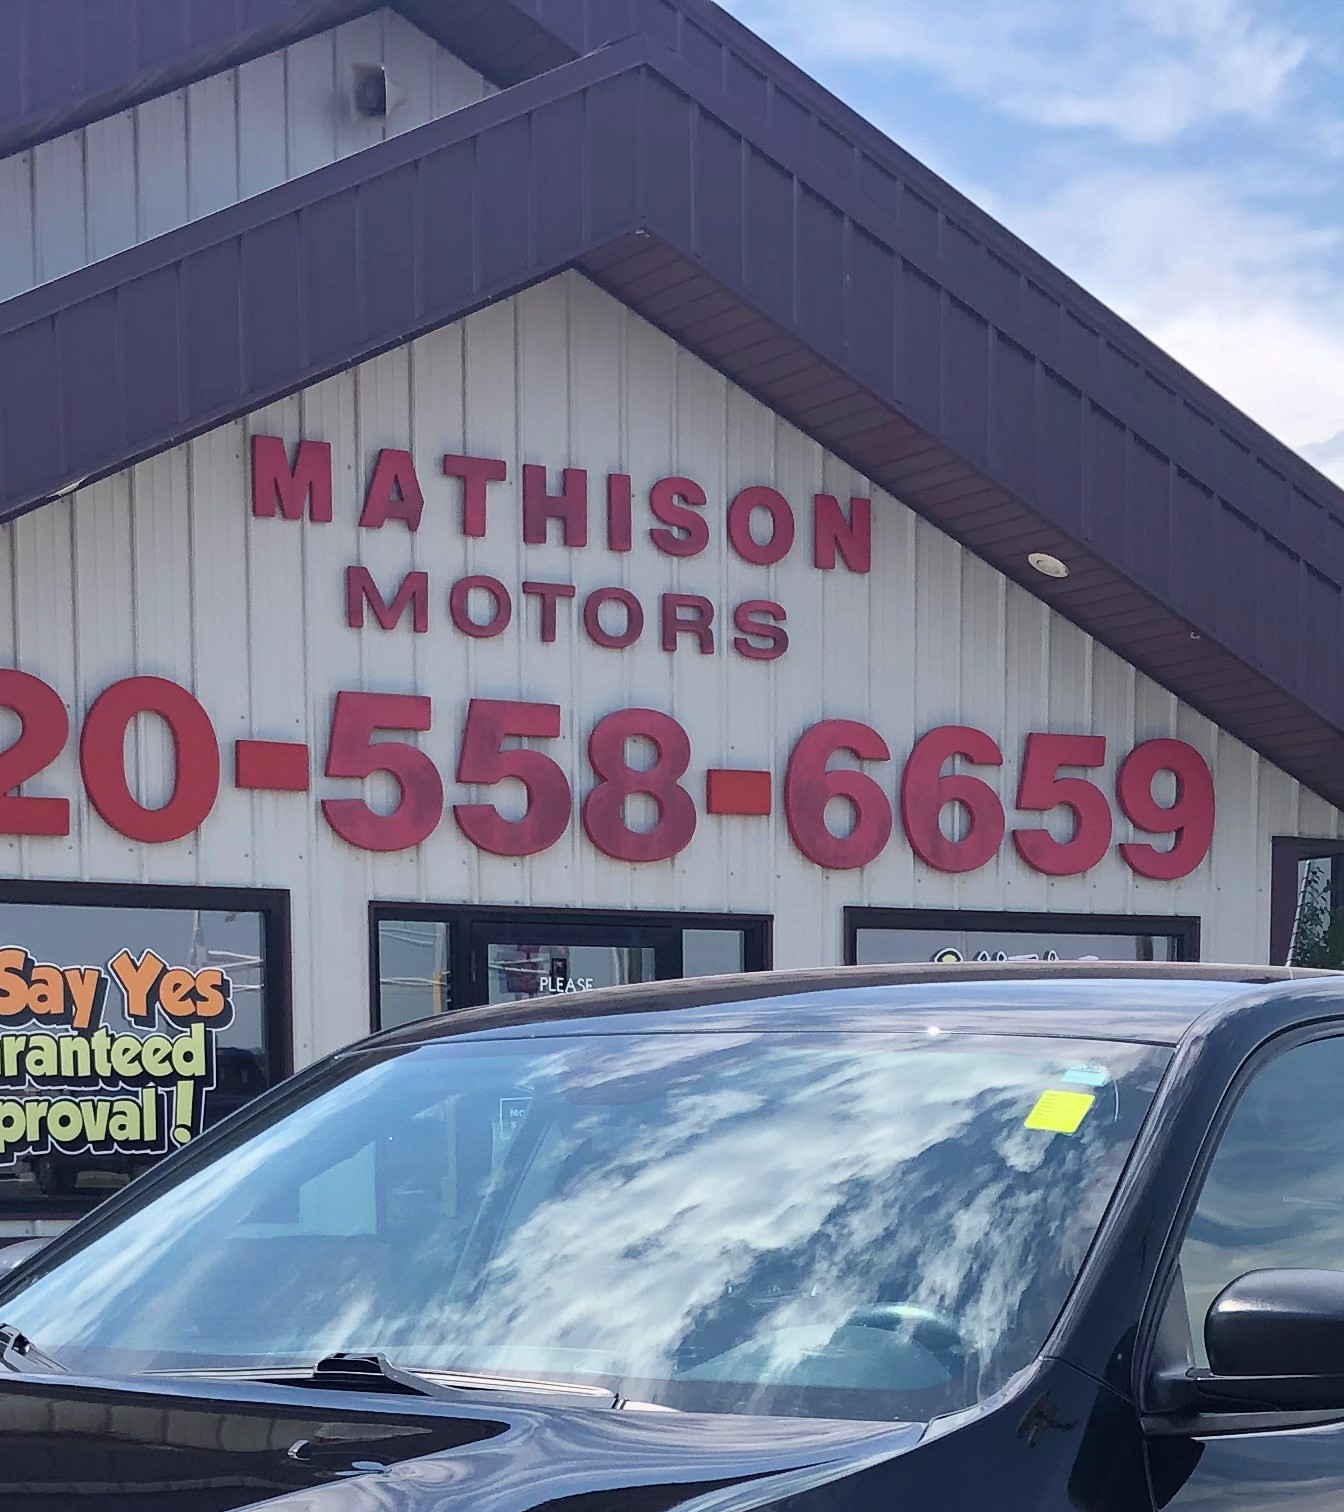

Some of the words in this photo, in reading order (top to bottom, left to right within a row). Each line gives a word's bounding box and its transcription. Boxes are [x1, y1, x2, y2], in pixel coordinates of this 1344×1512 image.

[252, 434, 872, 574] MATHISON
[346, 565, 789, 660] MOTORS
[109, 949, 227, 1018] Yes
[539, 976, 594, 993] PLEASE
